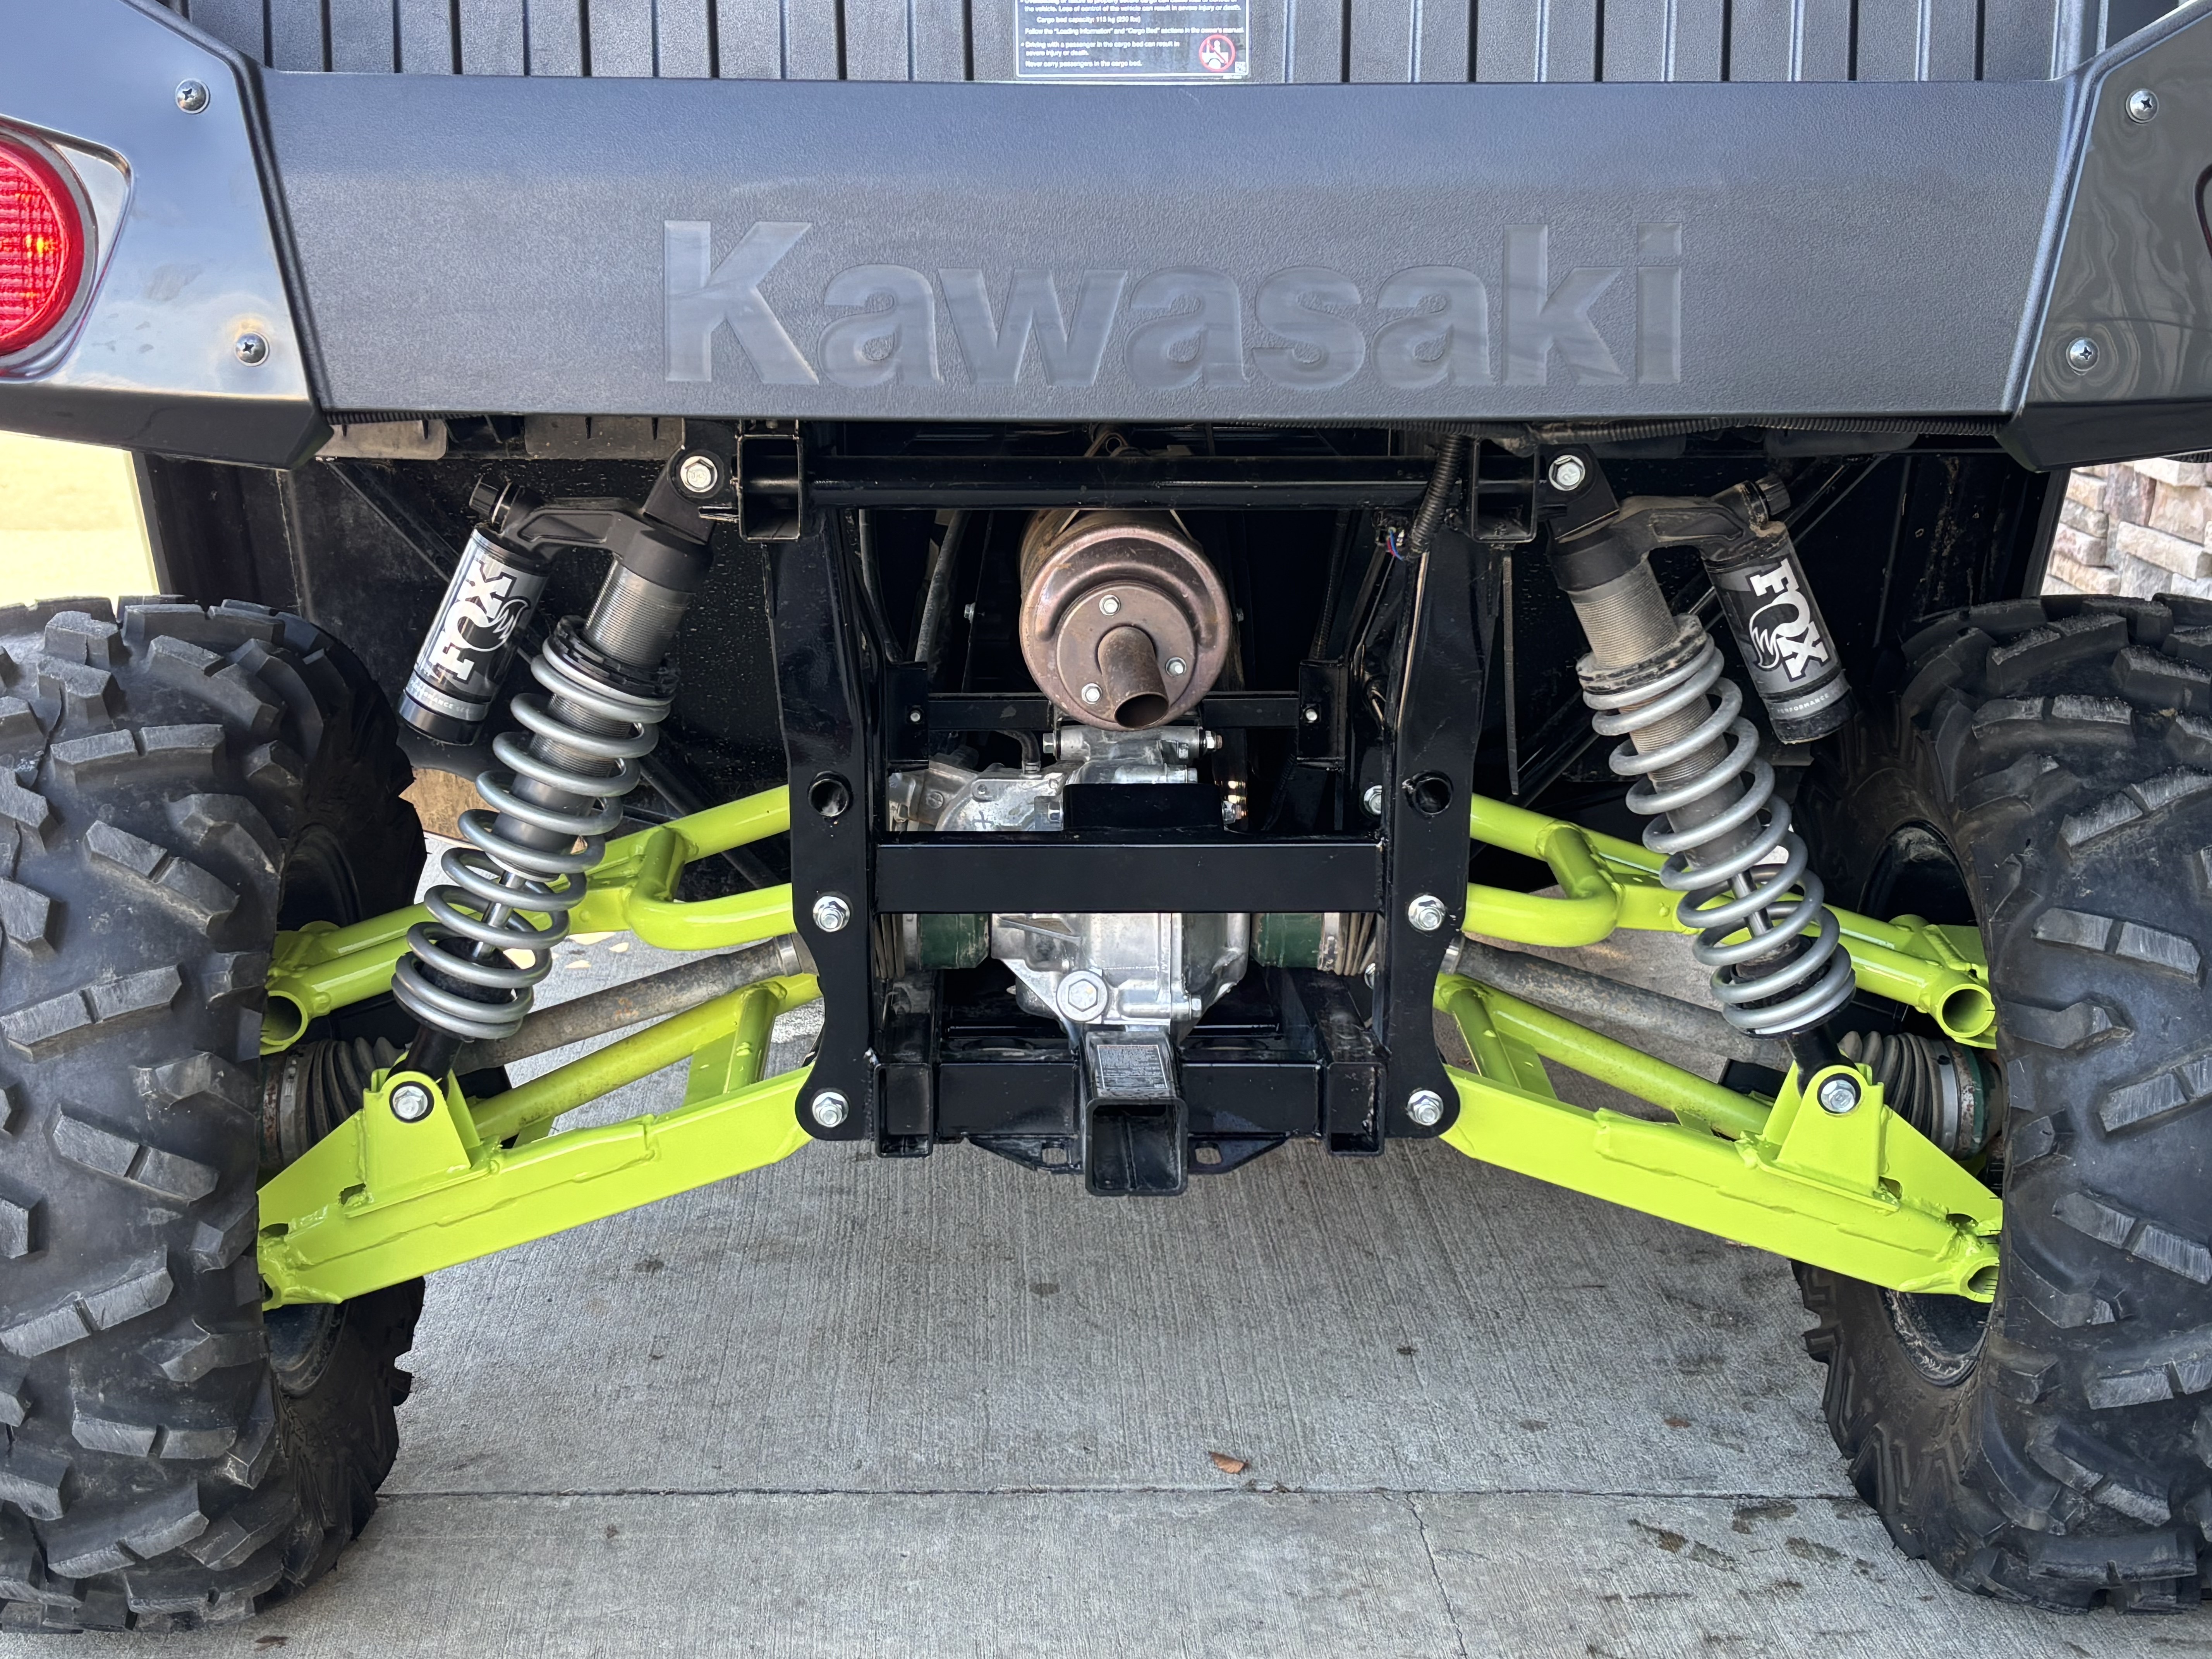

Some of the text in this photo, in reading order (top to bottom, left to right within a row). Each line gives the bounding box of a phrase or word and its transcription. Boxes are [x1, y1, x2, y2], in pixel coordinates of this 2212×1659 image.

[663, 220, 1682, 388] Kawasaki
[428, 559, 529, 681] FOX
[1749, 558, 1829, 678] FOX
